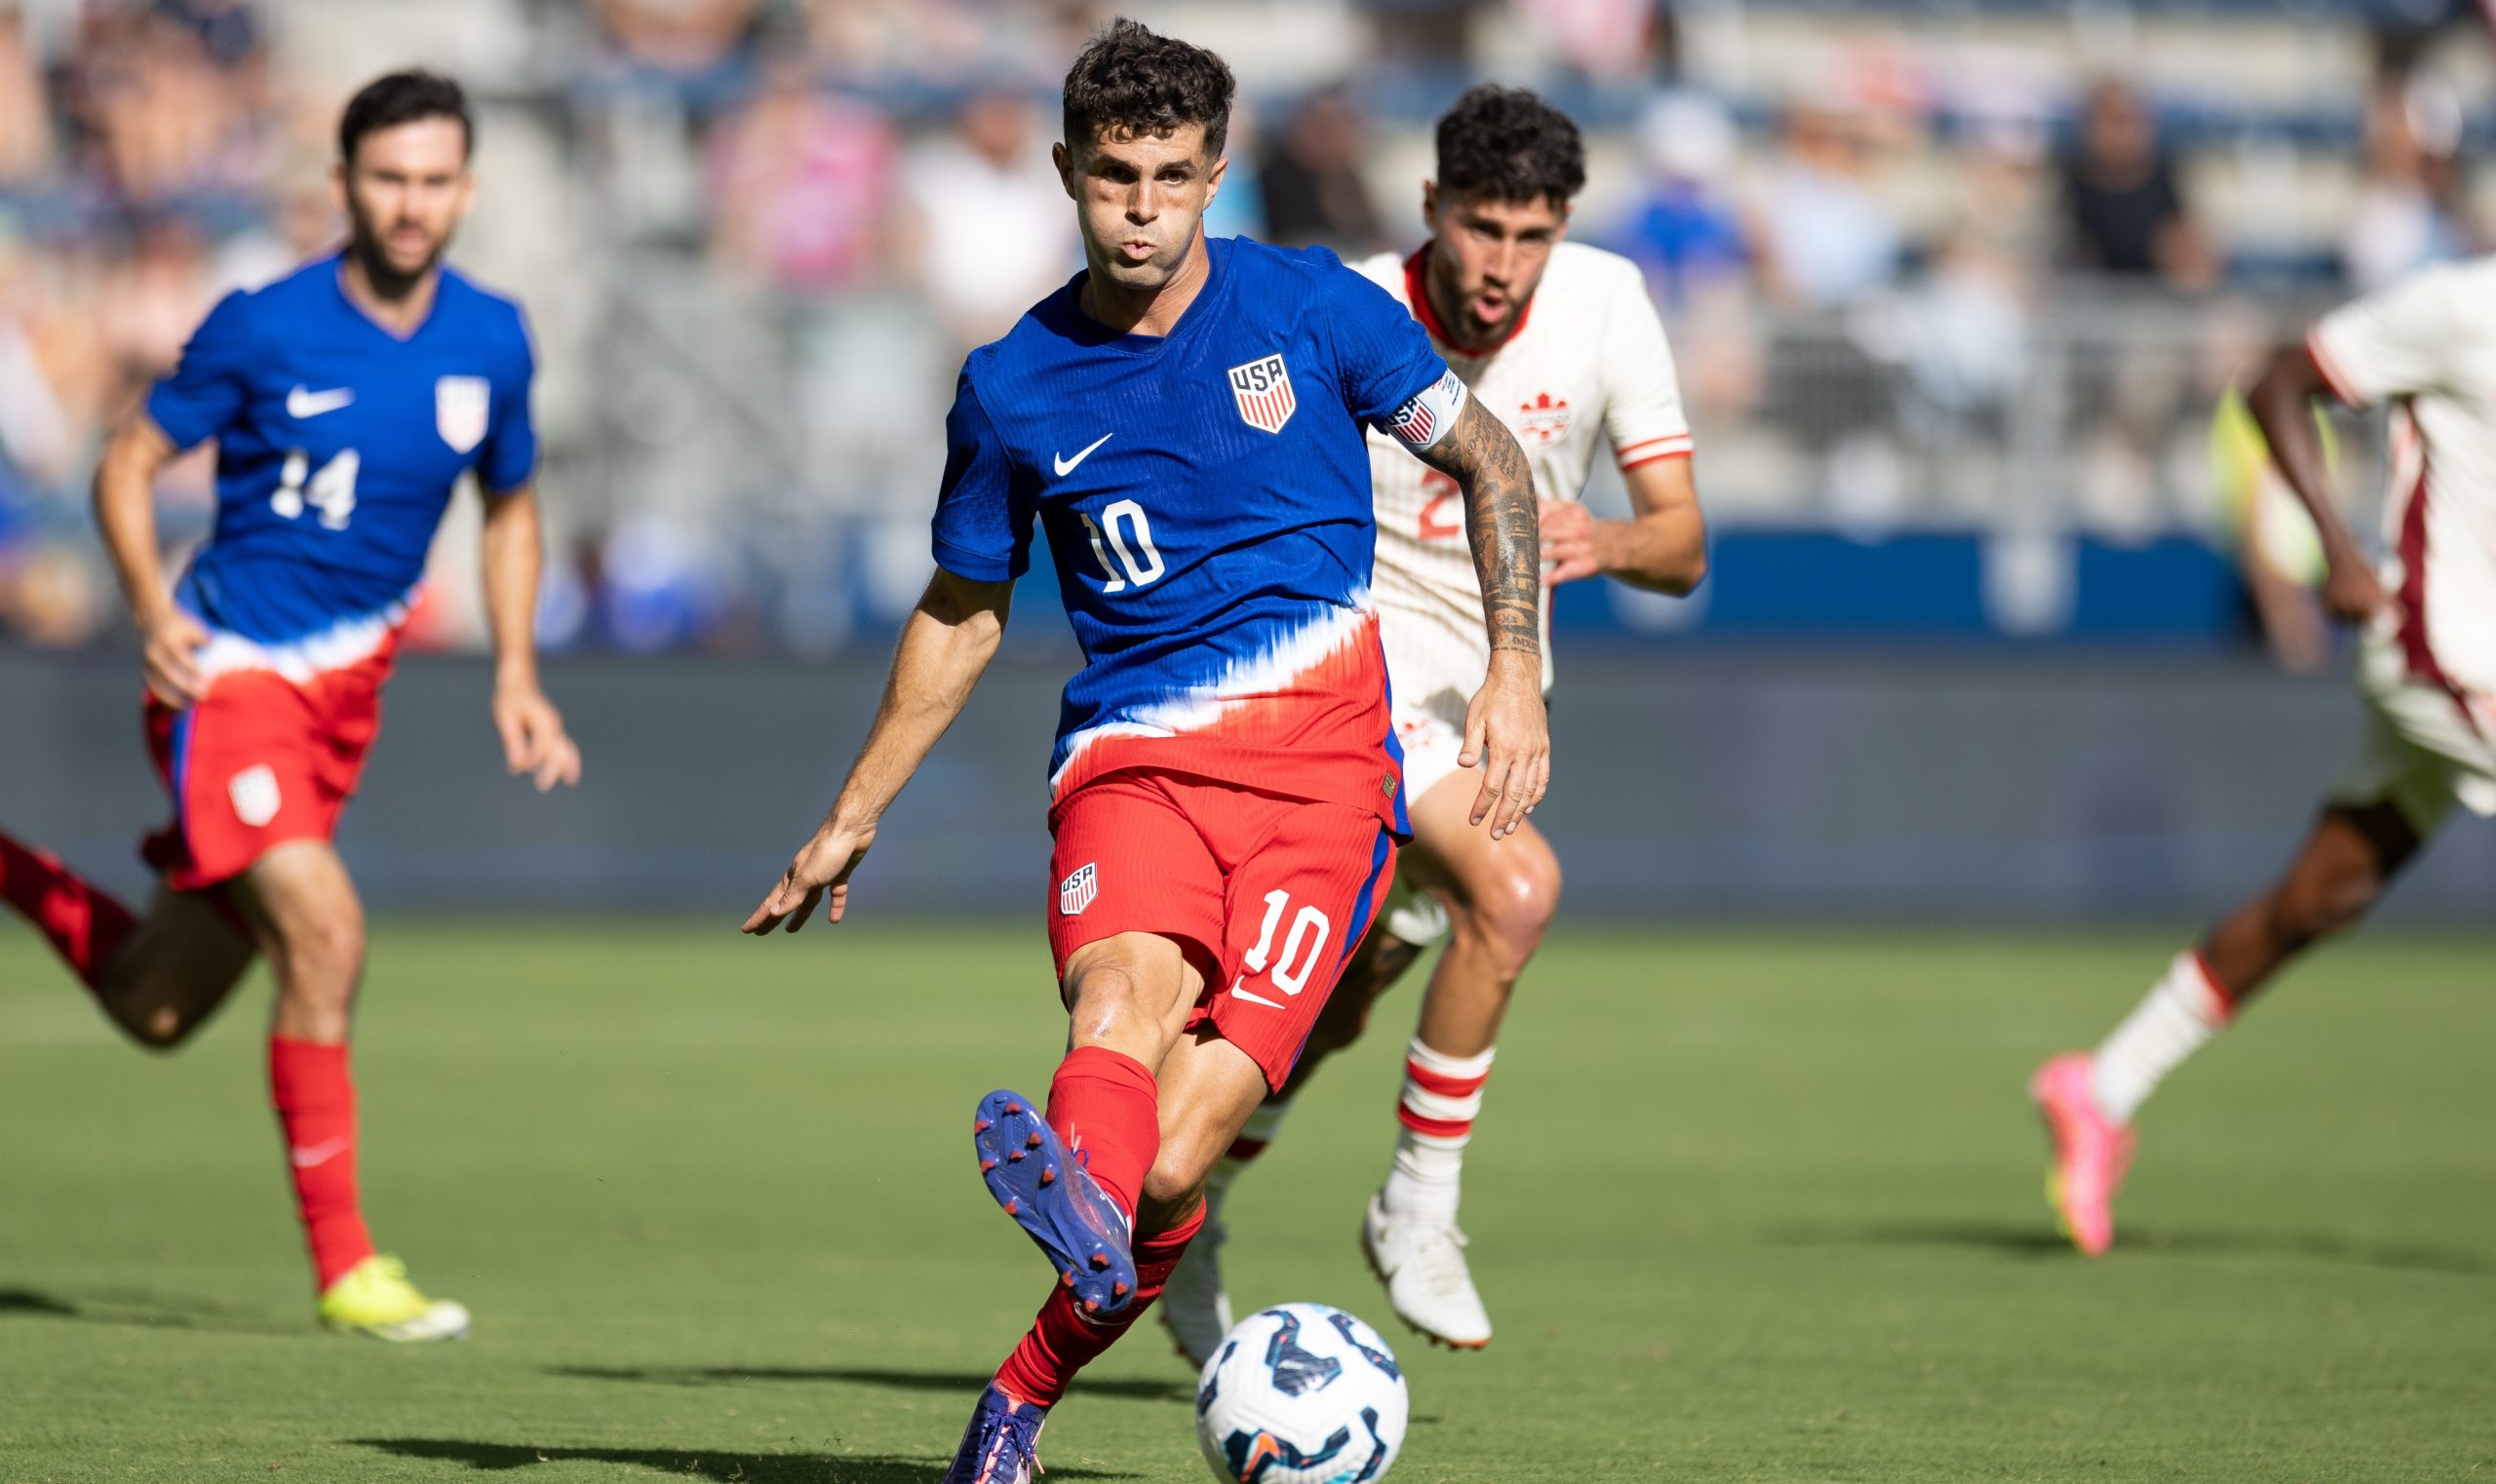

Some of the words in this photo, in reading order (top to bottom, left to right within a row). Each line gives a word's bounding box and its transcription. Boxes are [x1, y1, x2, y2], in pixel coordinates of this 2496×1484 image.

[1232, 358, 1283, 392] USA
[270, 448, 361, 531] 14
[1079, 498, 1165, 593] 10
[1063, 865, 1093, 892] USA
[1243, 888, 1330, 996] 10
